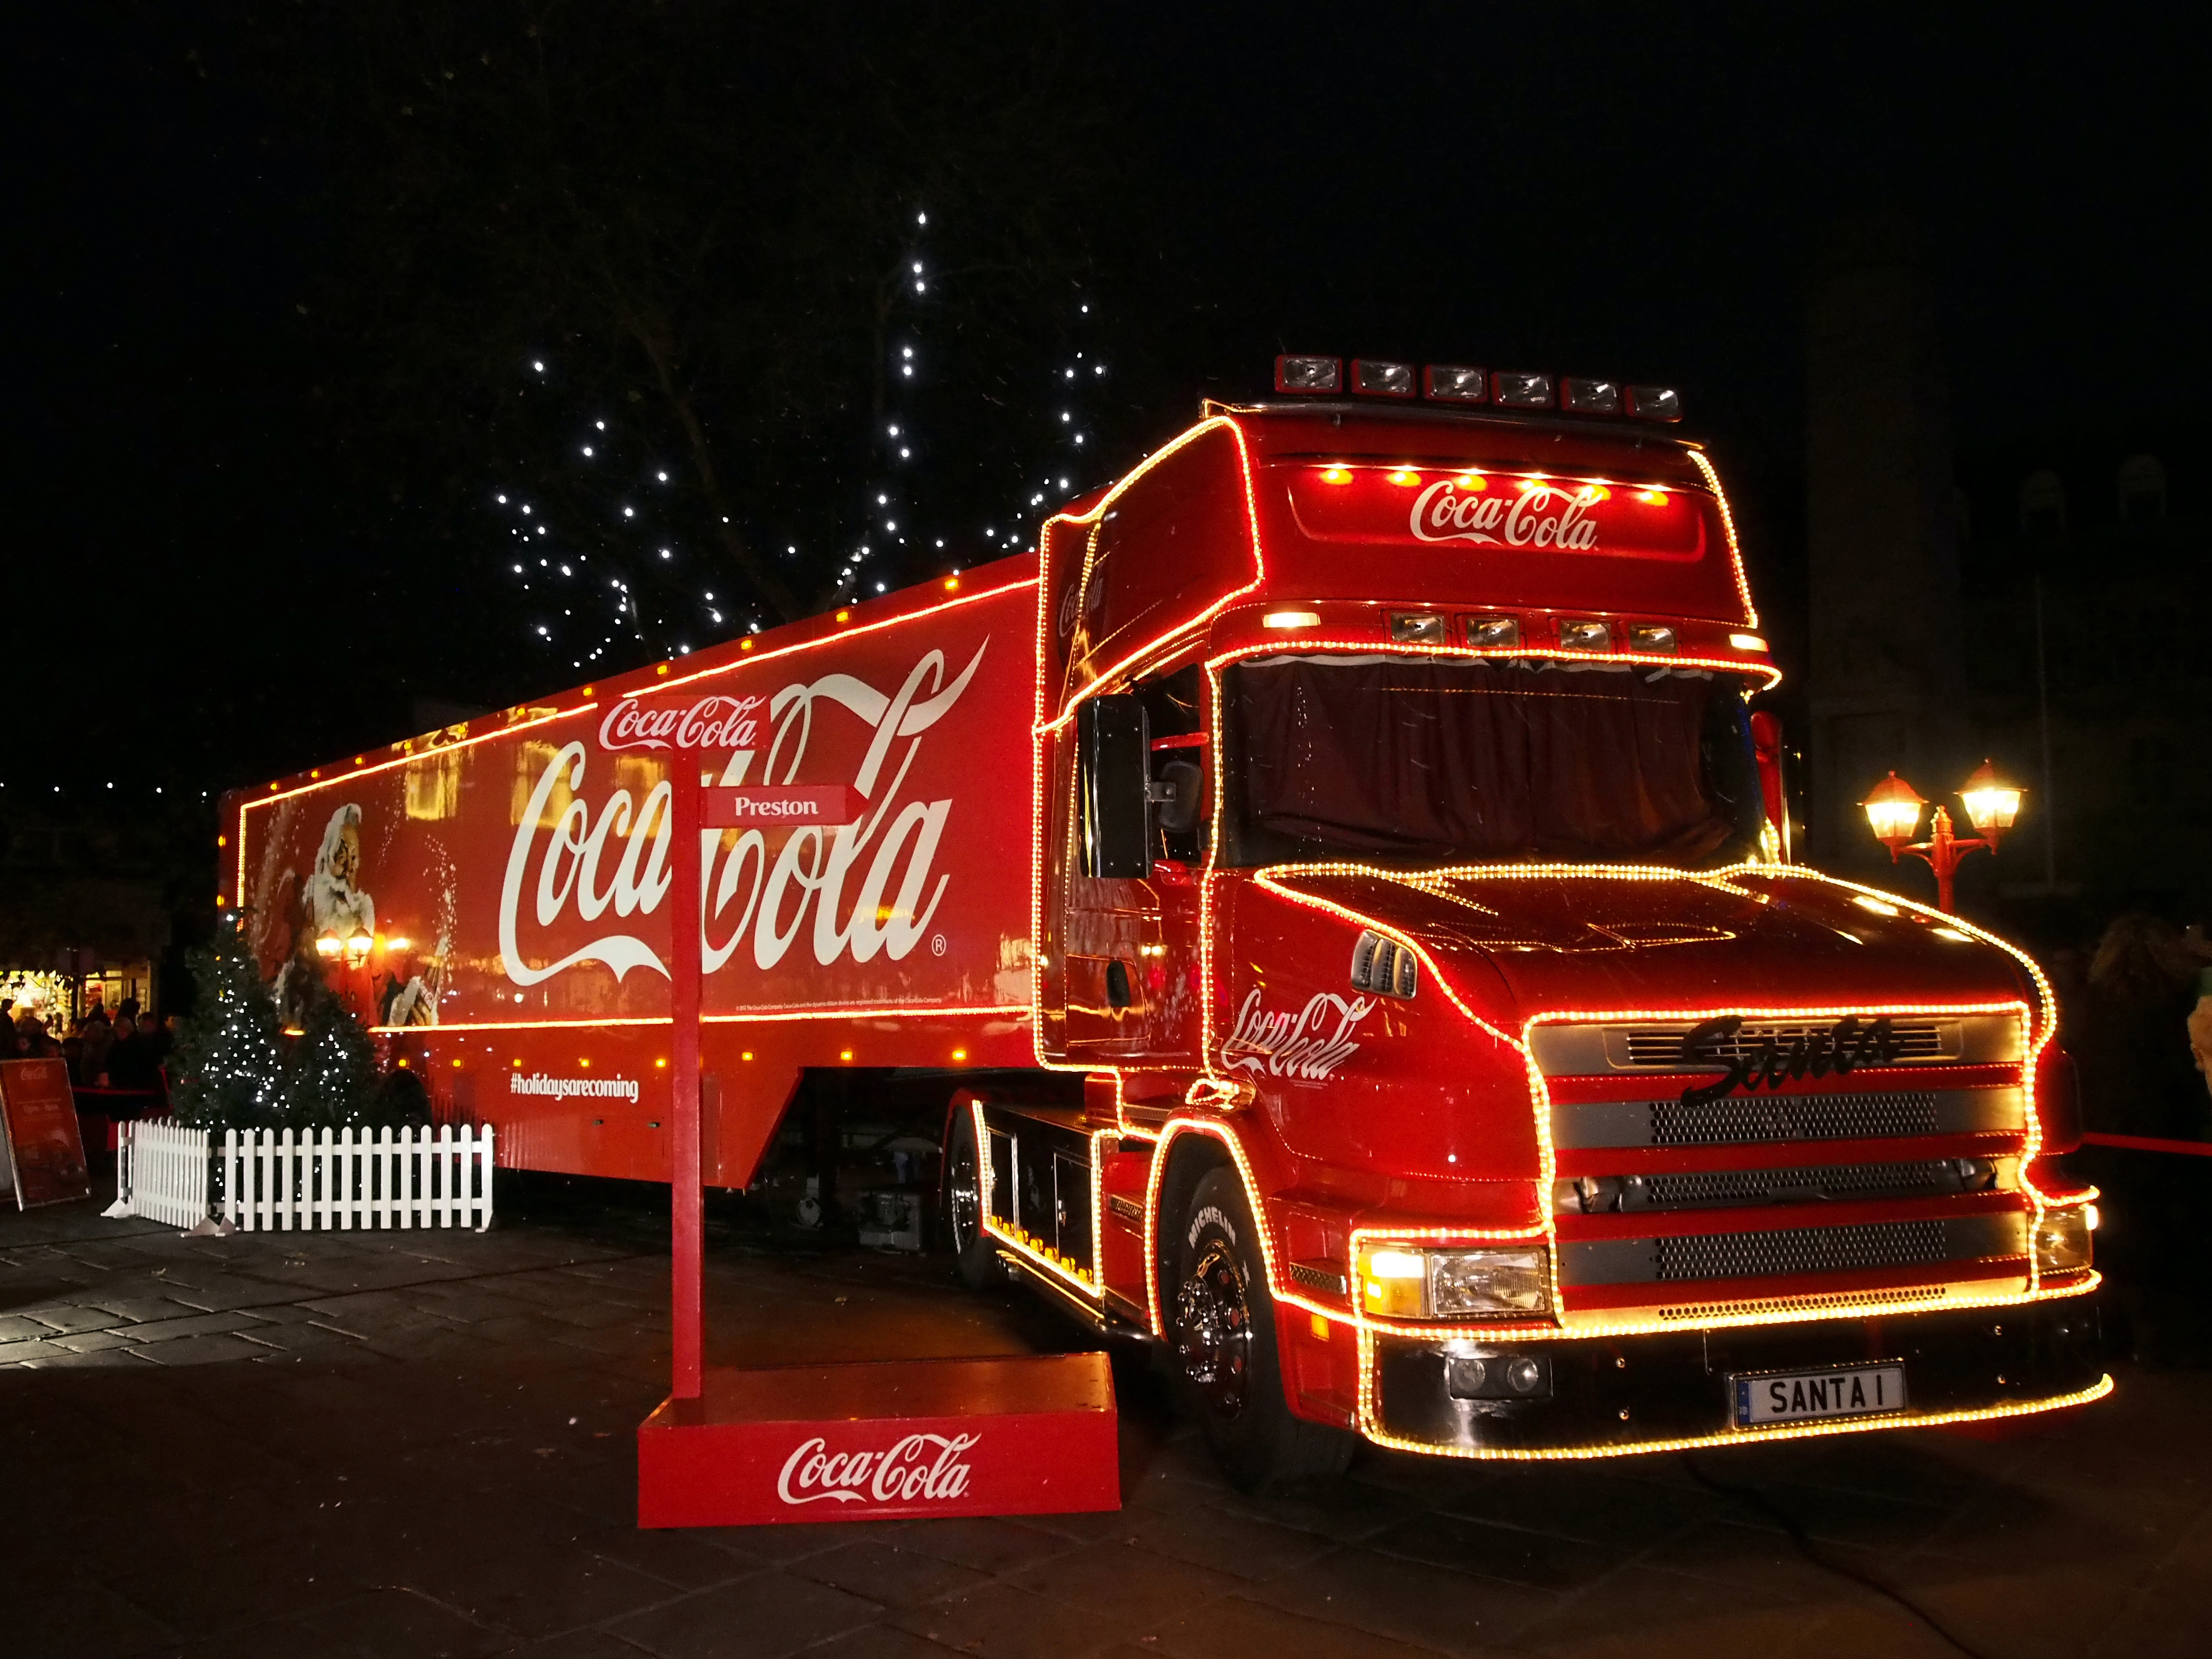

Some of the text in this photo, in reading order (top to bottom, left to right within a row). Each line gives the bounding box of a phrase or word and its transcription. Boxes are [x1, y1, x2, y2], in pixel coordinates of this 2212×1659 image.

[1410, 480, 1603, 551] Coca-Cola
[599, 696, 766, 750] Coca-Cola
[735, 797, 818, 816] Preston
[1221, 988, 1377, 1080] Coca-Cola
[511, 1072, 638, 1103] #holidaysarecoming
[1188, 1205, 1236, 1250] MICHELIN
[1770, 1376, 1866, 1413] SANTA
[778, 1432, 982, 1504] Coca-Cola
